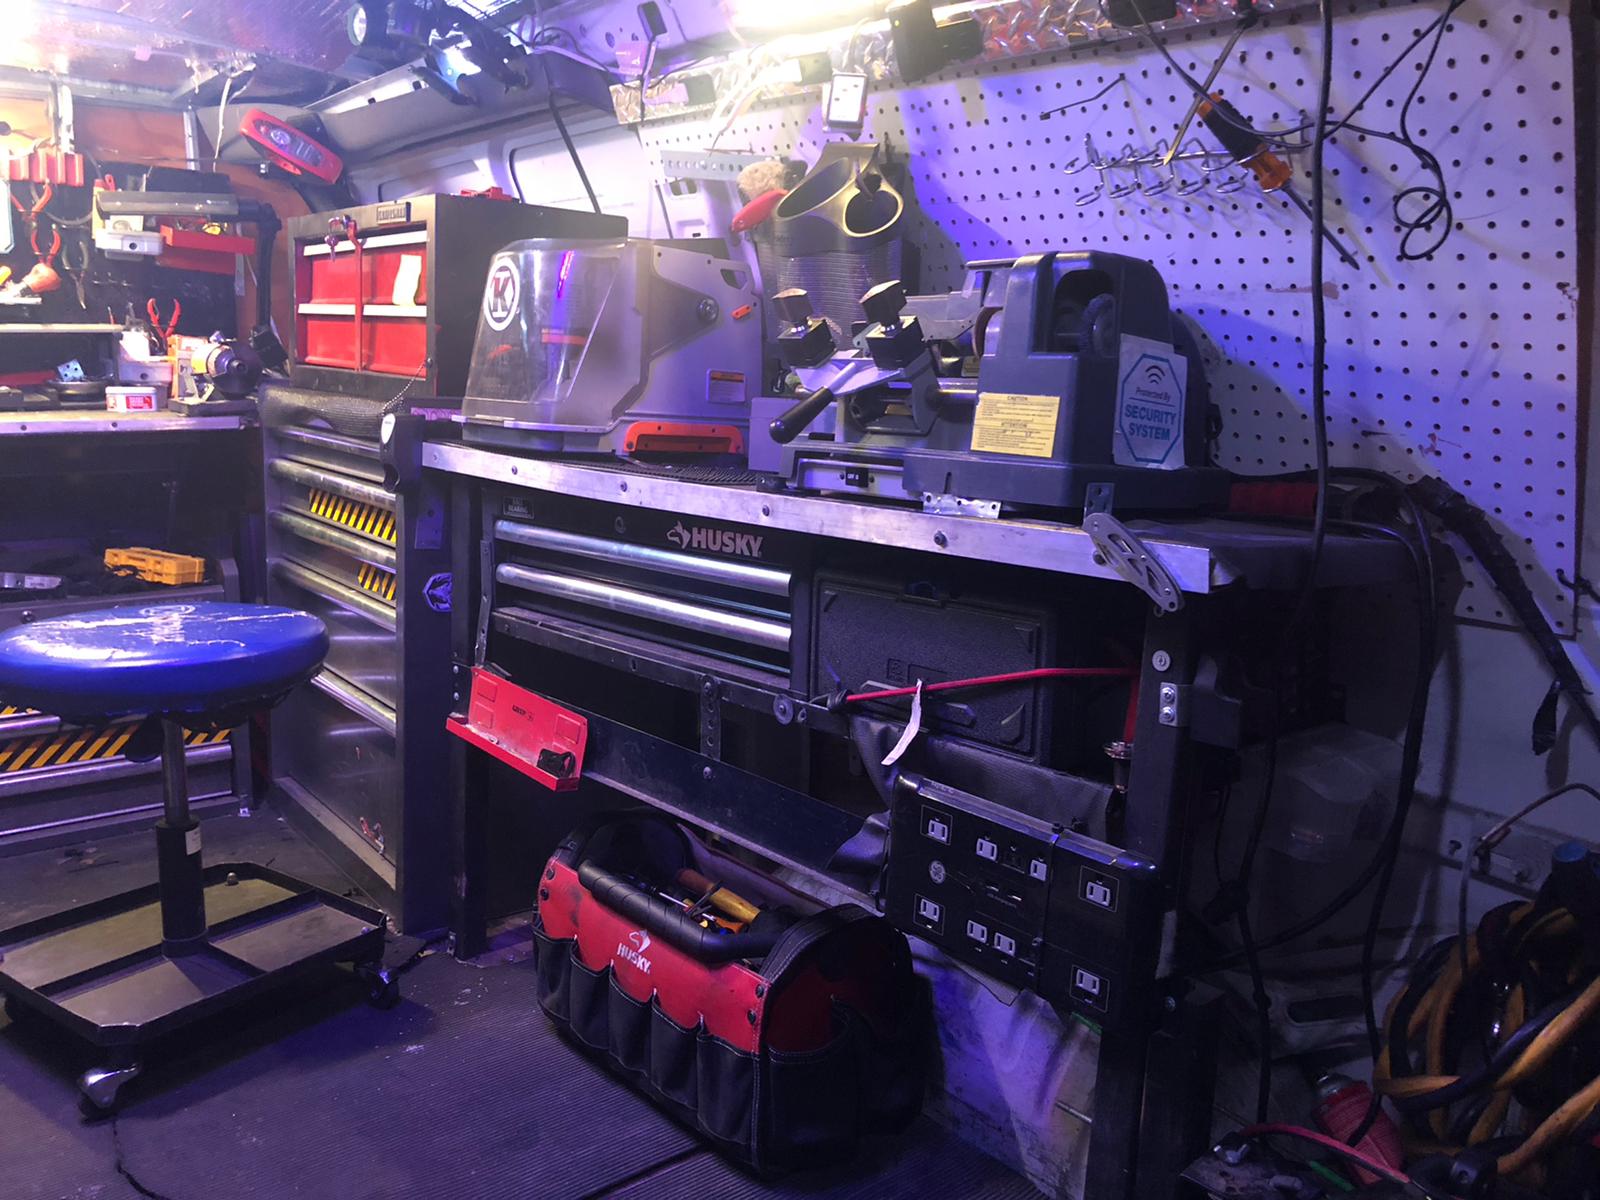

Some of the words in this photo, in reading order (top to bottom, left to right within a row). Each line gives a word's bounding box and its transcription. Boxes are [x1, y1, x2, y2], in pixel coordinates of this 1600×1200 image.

[1124, 403, 1177, 425] SECURITY
[1128, 422, 1170, 441] SYSTEM
[691, 527, 764, 558] HUSKY
[616, 942, 652, 974] HUSKY
